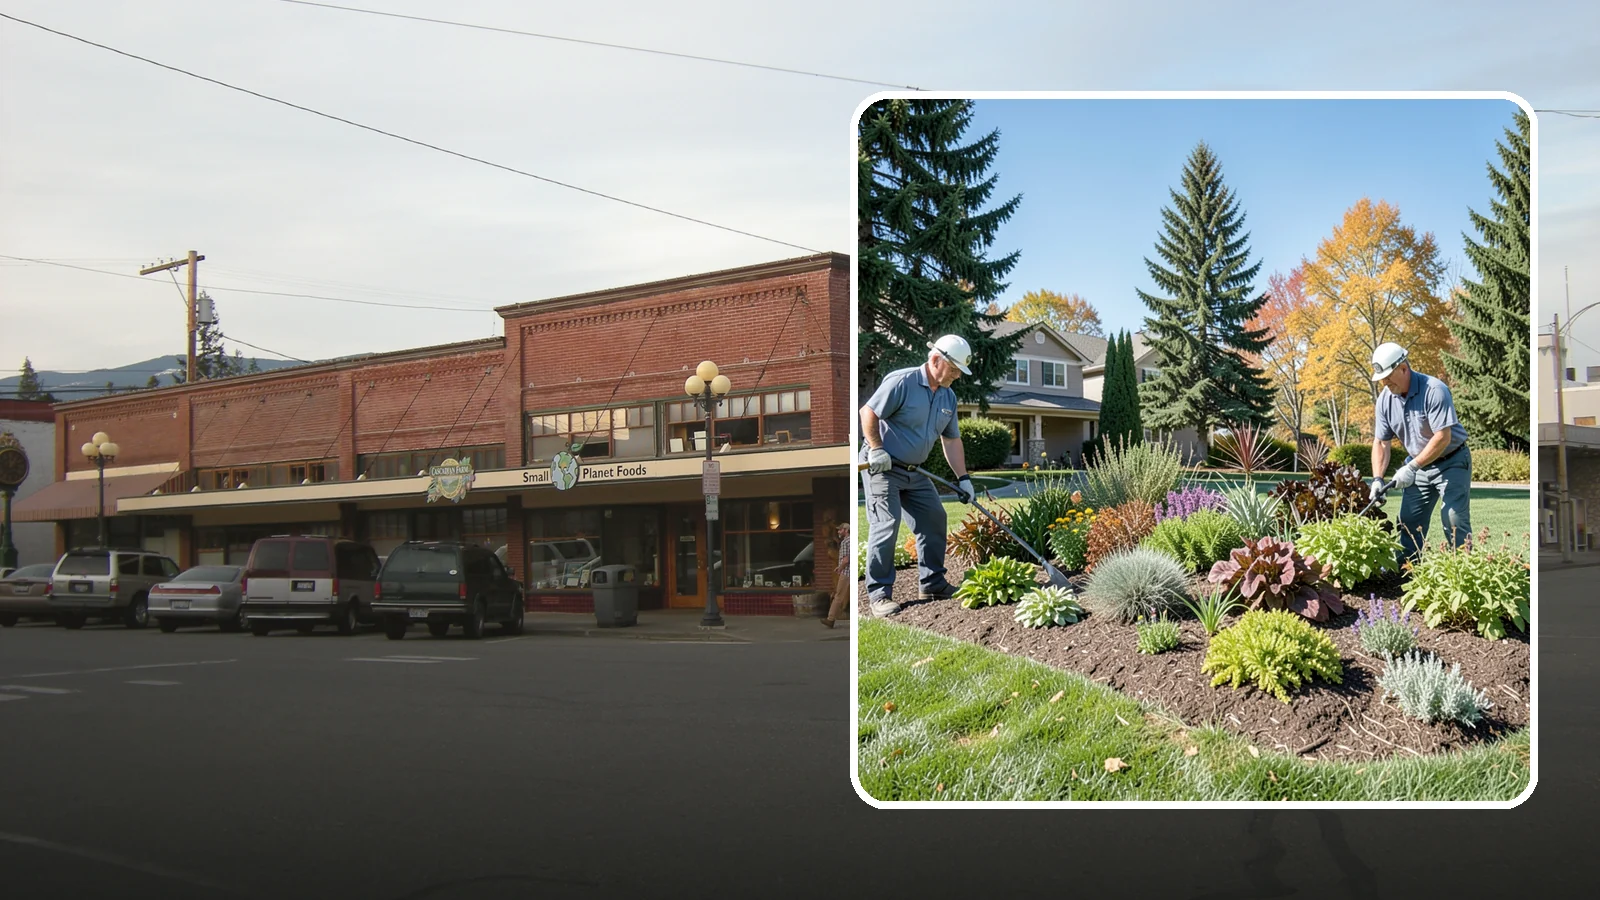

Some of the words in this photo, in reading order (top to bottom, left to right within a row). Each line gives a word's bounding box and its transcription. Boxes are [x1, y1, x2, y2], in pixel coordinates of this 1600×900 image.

[523, 471, 549, 483] Small
[582, 467, 614, 479] Planet
[616, 464, 647, 477] Foods
